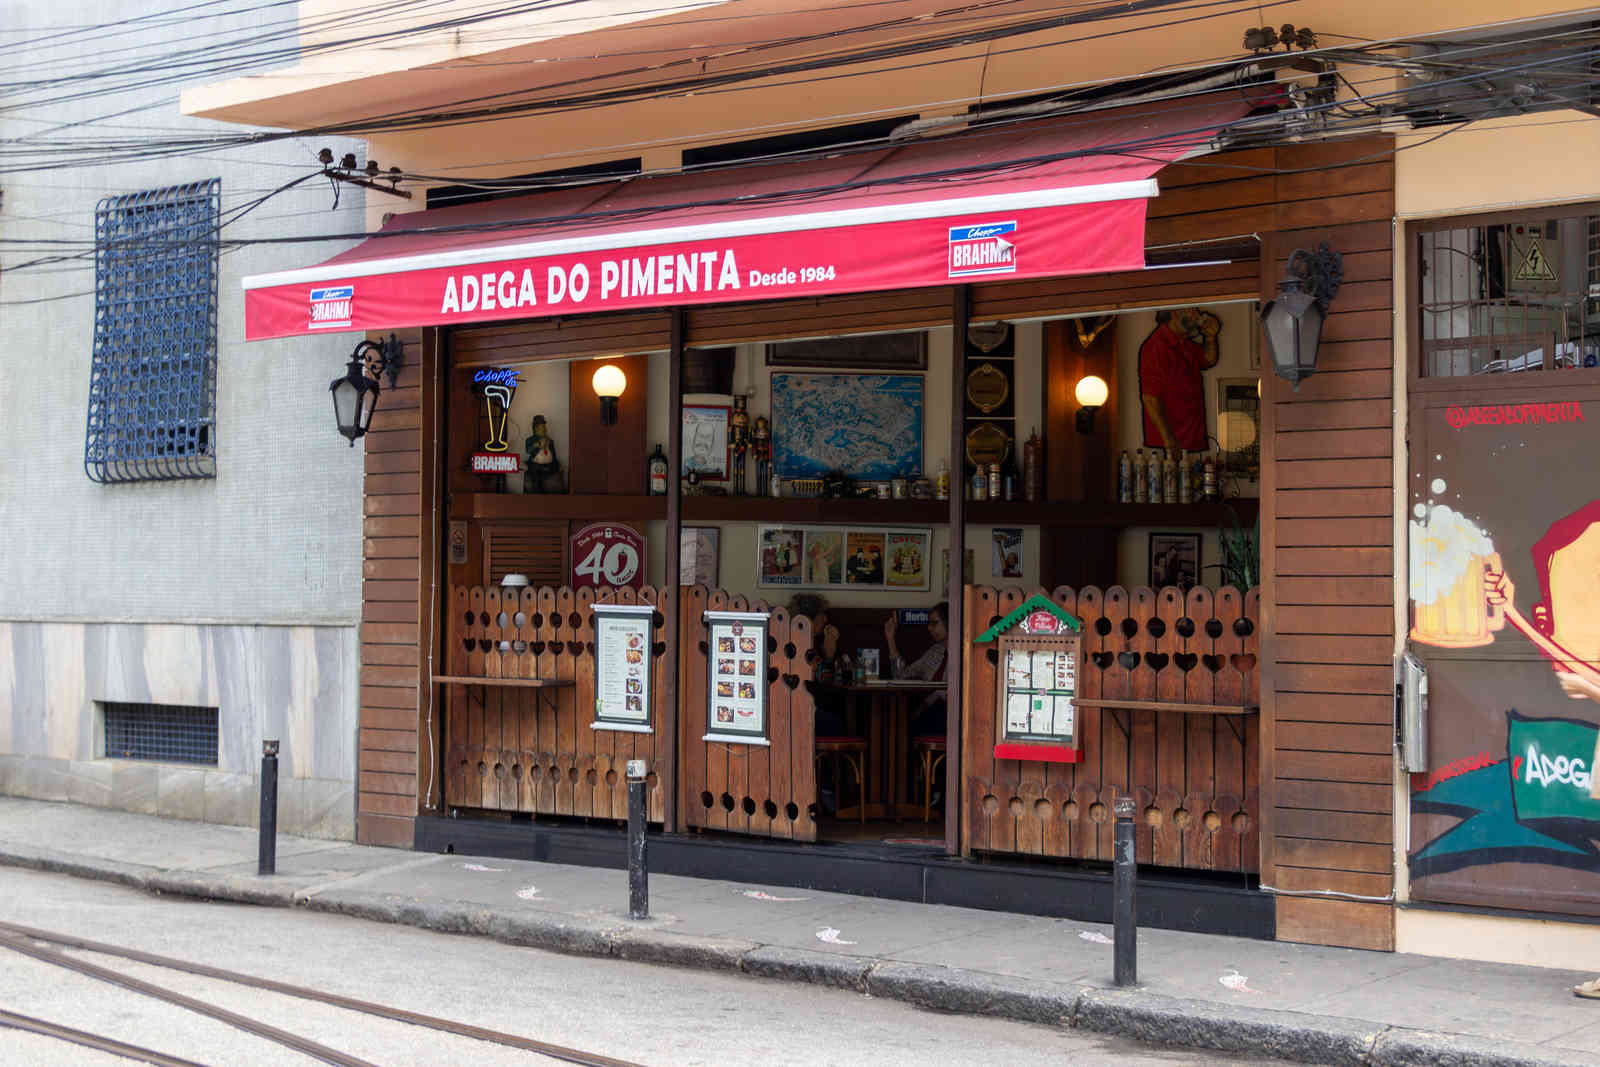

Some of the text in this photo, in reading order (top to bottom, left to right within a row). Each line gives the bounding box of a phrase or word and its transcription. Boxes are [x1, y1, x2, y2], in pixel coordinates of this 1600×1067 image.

[953, 242, 1011, 267] BRAHMA
[441, 249, 836, 314] ADEGA DO PIMENTA Desde 1984
[473, 456, 518, 471] BRAHMA
[575, 542, 639, 585] 40
